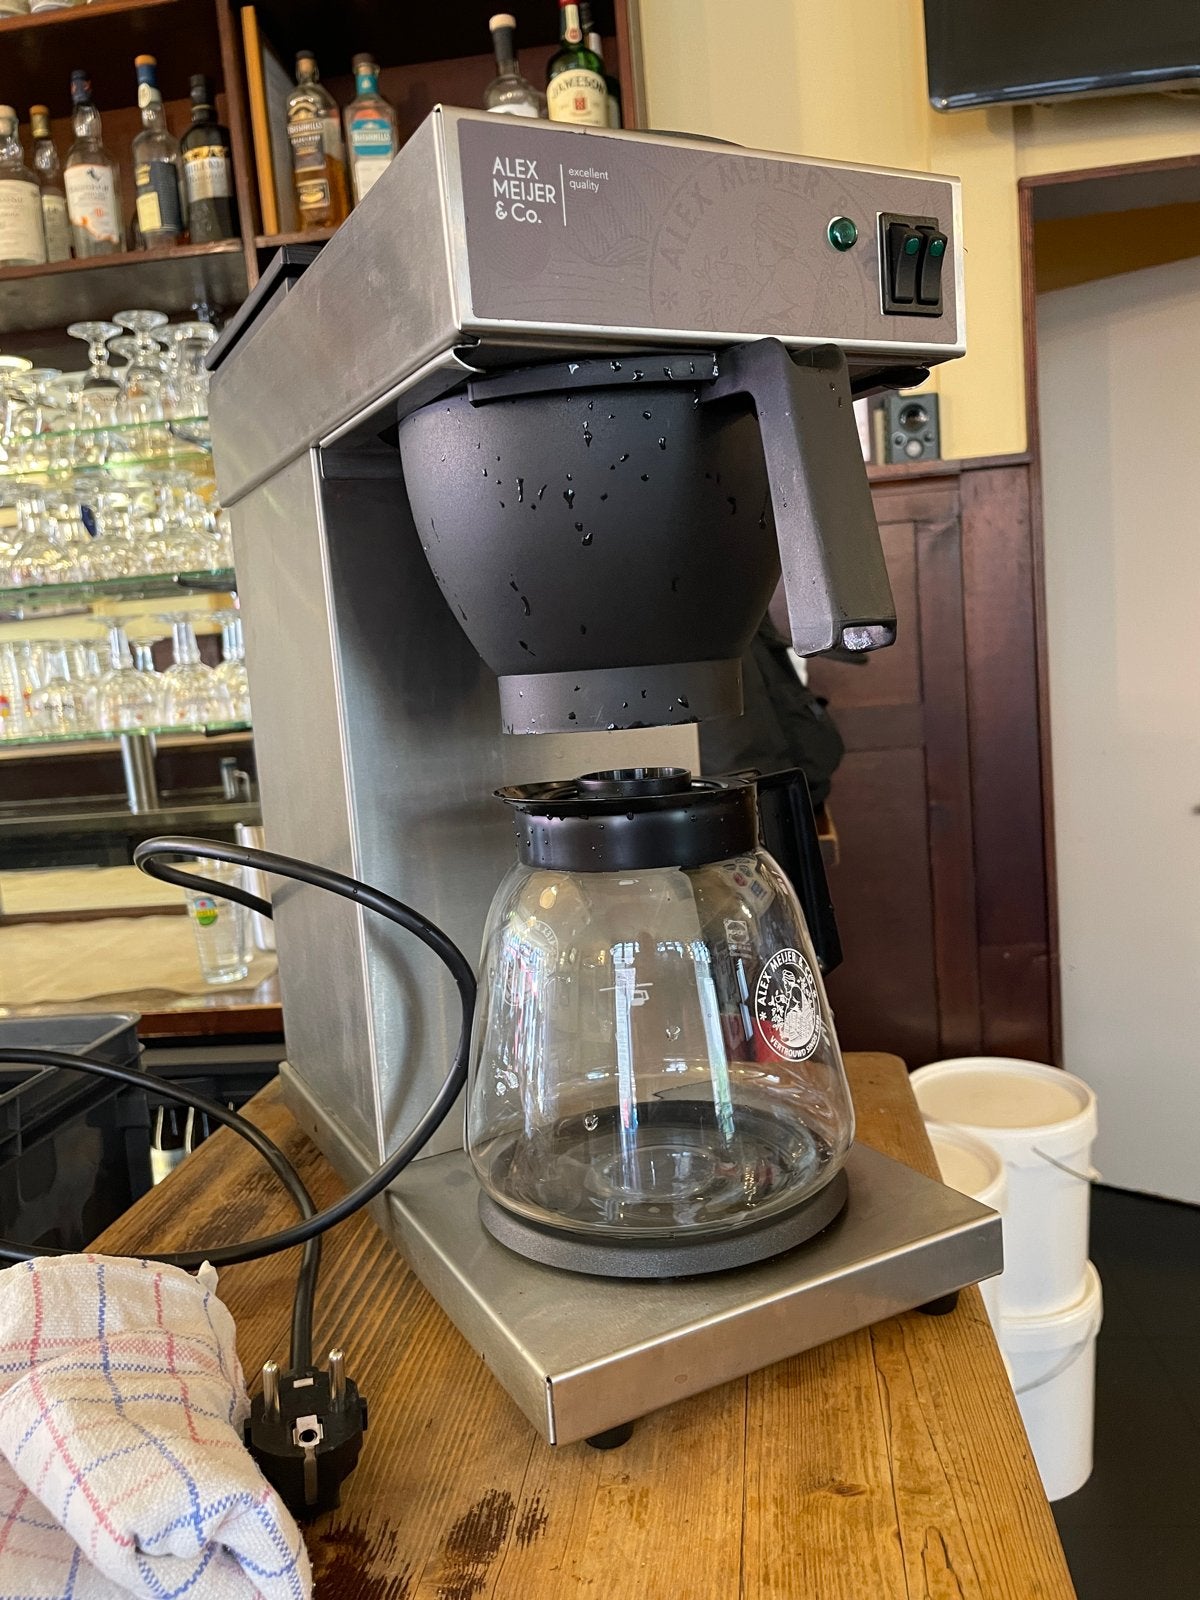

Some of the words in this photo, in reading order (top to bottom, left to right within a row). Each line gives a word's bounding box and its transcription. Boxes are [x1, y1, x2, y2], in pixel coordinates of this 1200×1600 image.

[492, 156, 539, 180] ALEX
[568, 168, 609, 181] excellent
[493, 178, 557, 204] MEIJER
[569, 180, 600, 193] quality
[495, 201, 508, 220] &
[511, 203, 542, 224] Co.
[757, 970, 772, 1006] ALEX
[769, 951, 797, 973] MEIJER
[770, 1035, 806, 1058] VERTROUWD
